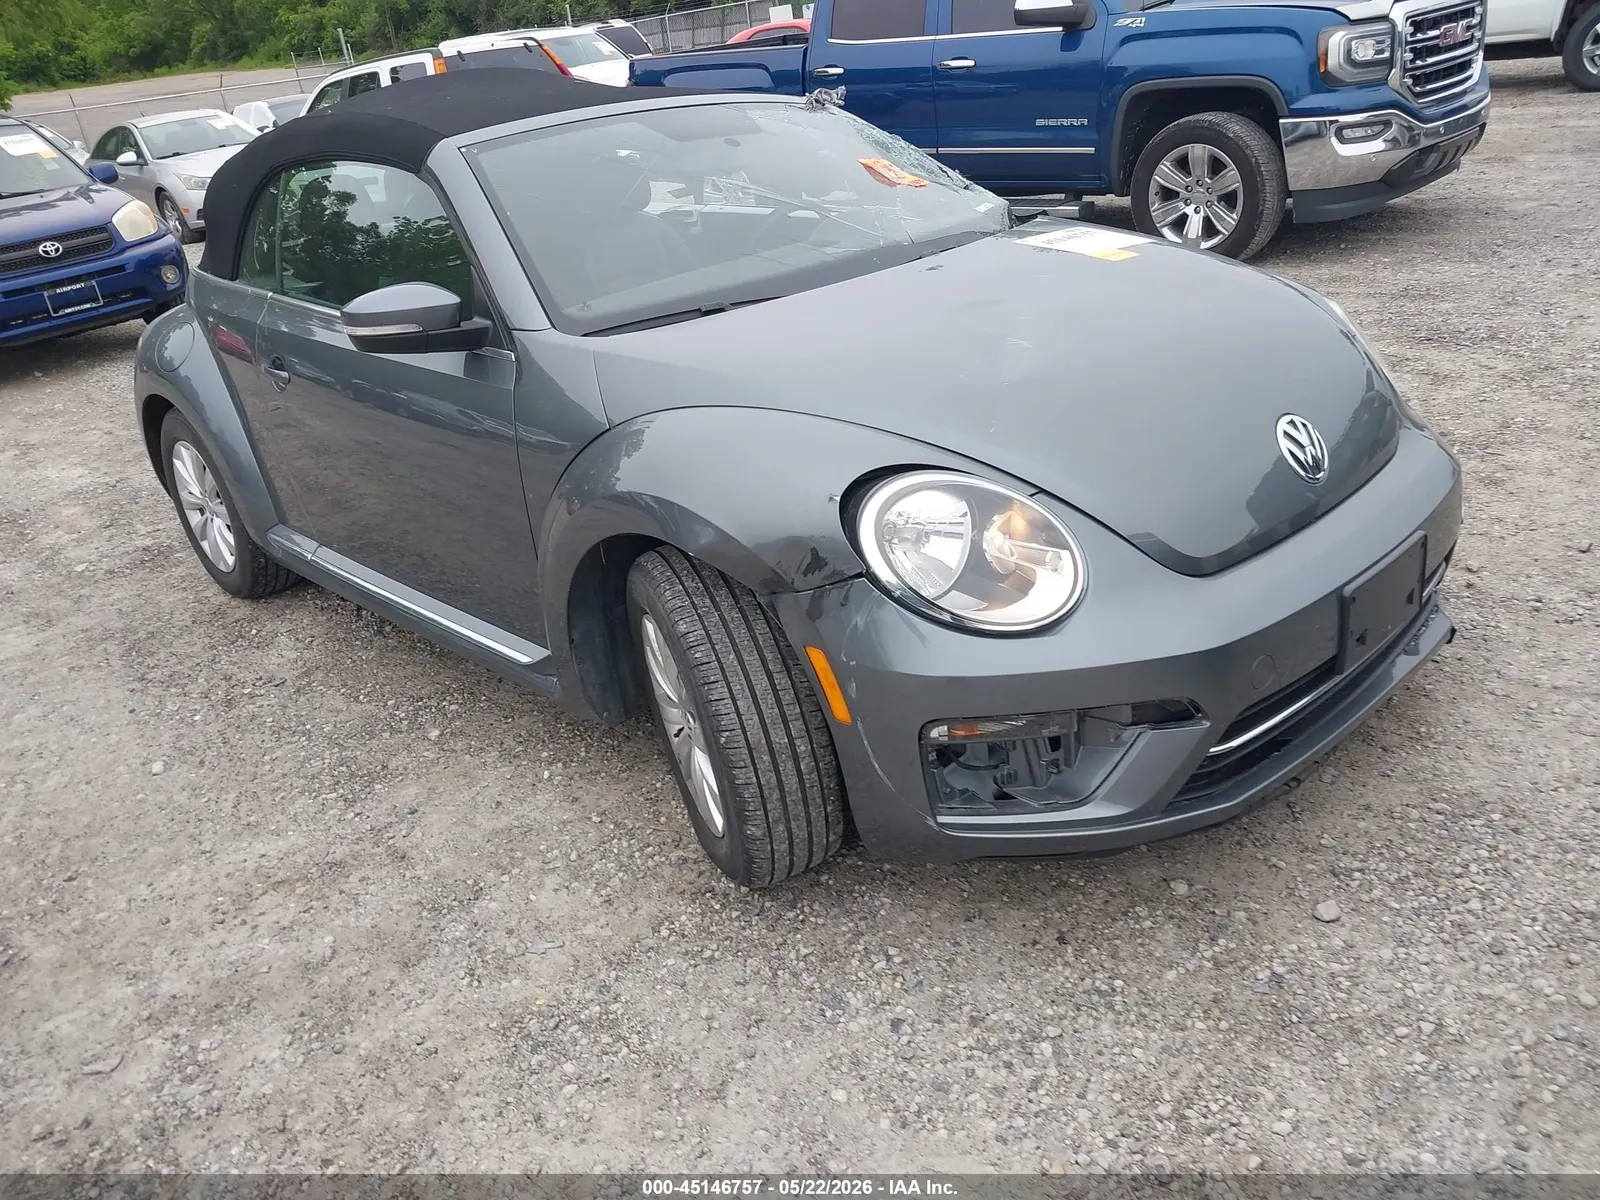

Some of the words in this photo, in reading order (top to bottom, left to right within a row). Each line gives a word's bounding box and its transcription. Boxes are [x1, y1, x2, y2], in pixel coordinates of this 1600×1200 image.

[1439, 18, 1473, 47] GMC
[1035, 118, 1088, 126] SIERRA
[56, 282, 85, 294] AIRPORT
